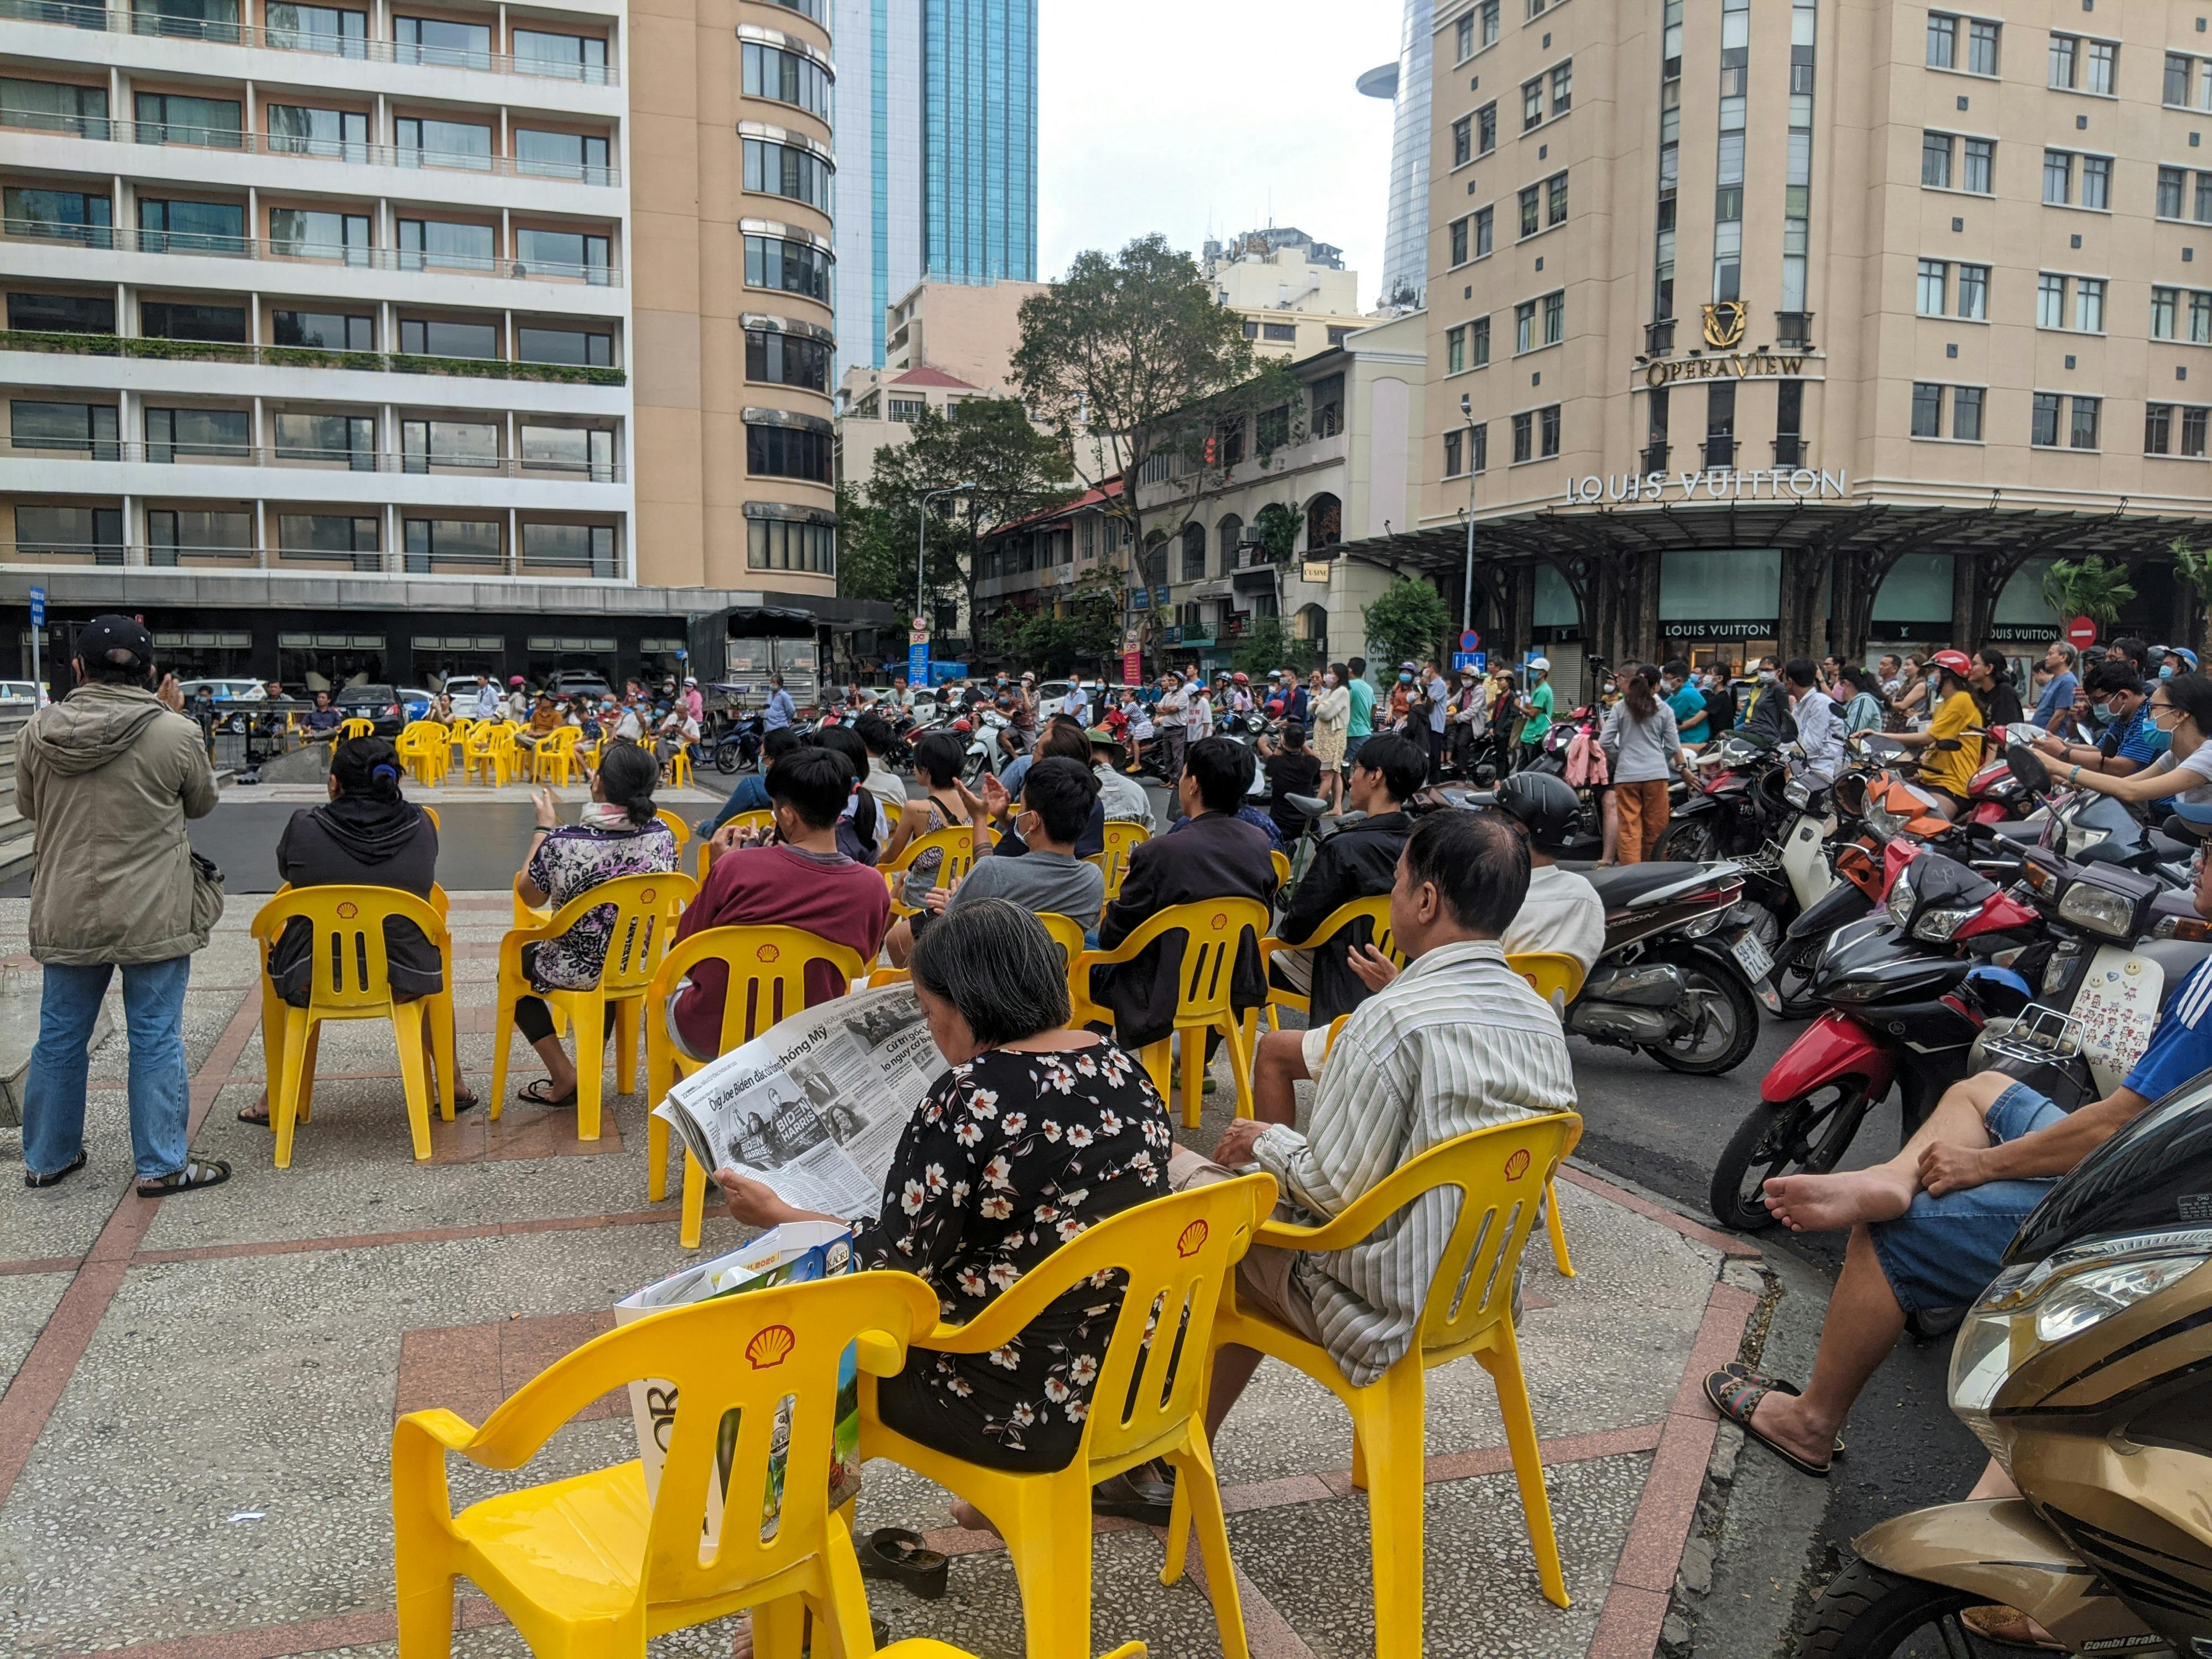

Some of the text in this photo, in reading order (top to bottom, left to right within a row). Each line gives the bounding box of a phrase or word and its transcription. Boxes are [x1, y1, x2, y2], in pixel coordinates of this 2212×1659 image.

[1567, 469, 1845, 502] LOUIS VUITTON
[1665, 624, 1771, 637] LOUIS VUITTON
[2015, 628, 2057, 640] VUITTON
[898, 1035, 908, 1045] tri
[909, 1027, 925, 1041] gốc
[880, 1036, 932, 1072] lo nguy cơ bạ
[723, 1089, 734, 1103] Joe
[733, 1077, 755, 1096] Biden
[779, 1046, 811, 1066] hống
[808, 1026, 827, 1045] Mỹ
[775, 1099, 810, 1133] BIDEN
[781, 1110, 816, 1142] HARRIS
[740, 1135, 764, 1152] BIDEN
[744, 1146, 768, 1160] HARRIS
[827, 1250, 848, 1269] KAORI
[2083, 1637, 2125, 1651] Combi
